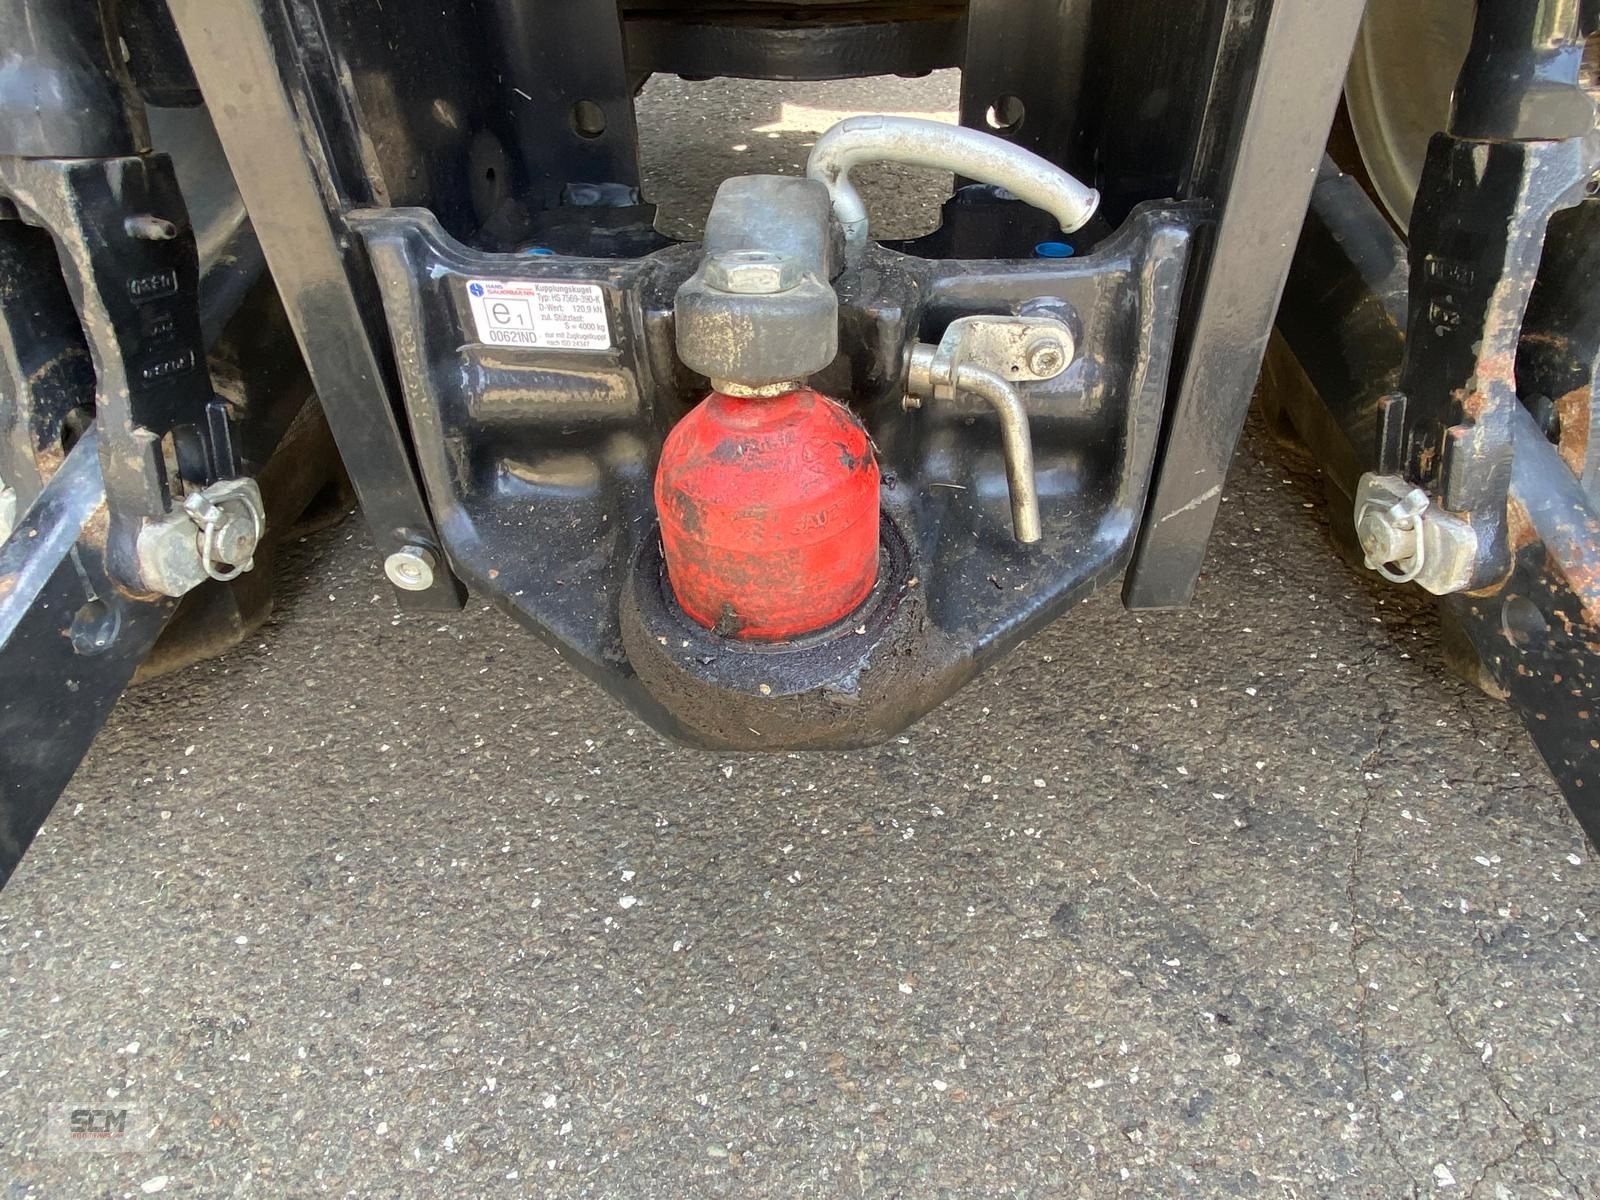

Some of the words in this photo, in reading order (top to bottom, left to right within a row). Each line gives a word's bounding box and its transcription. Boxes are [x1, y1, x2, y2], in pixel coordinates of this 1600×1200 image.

[535, 284, 592, 295] Kupplungskugel
[492, 303, 511, 324] e
[516, 313, 524, 326] 1
[596, 323, 606, 332] kg
